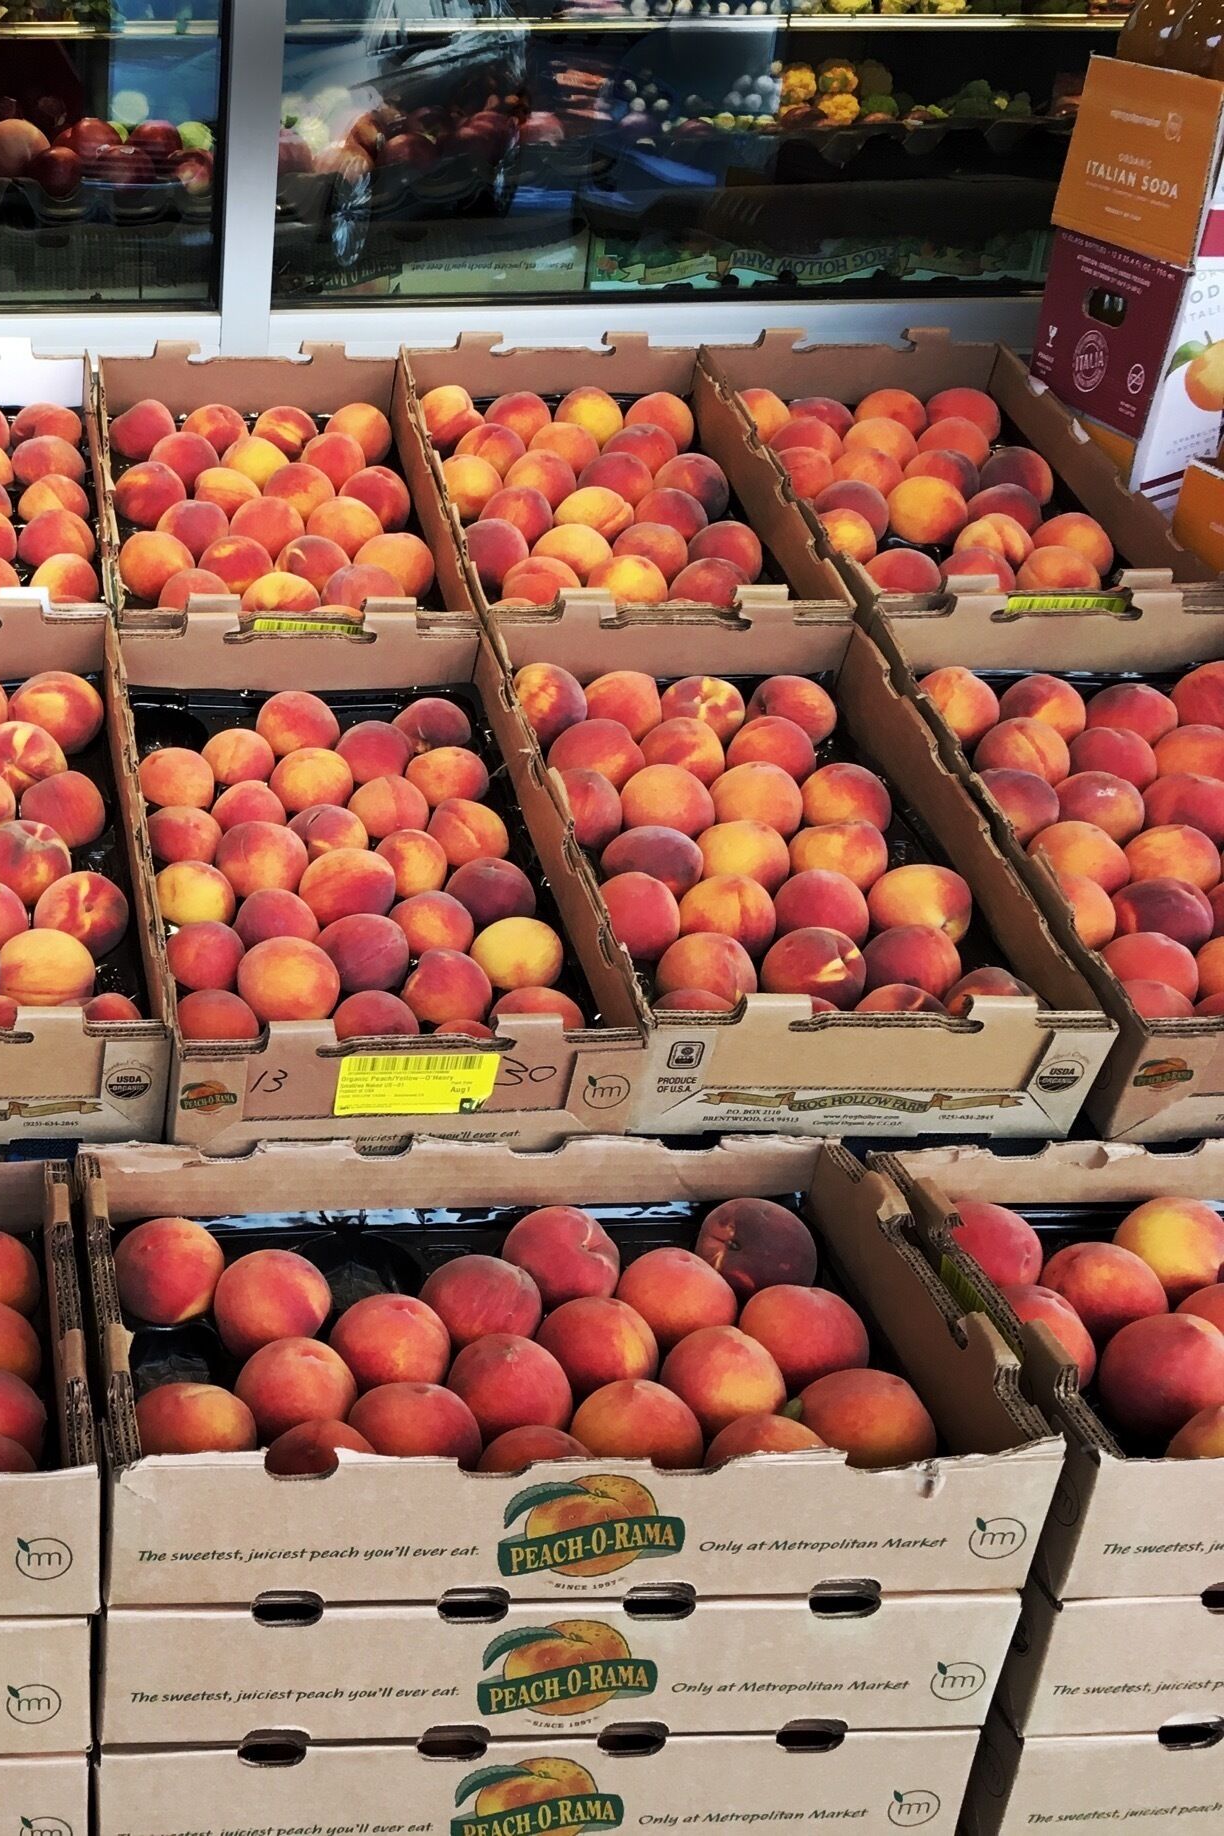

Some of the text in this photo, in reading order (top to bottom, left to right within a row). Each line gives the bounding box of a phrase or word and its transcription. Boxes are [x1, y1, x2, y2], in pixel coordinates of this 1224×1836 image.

[1086, 160, 1137, 188] ITALIAN
[1140, 175, 1179, 200] SODA
[1075, 351, 1105, 372] ITALIA
[495, 1056, 558, 1086] 30
[657, 1076, 698, 1084] PRODUCE
[1049, 1068, 1076, 1076] USDA
[250, 1069, 289, 1093] 13
[790, 1094, 927, 1112] FROG HOLLOW FARM
[138, 1544, 480, 1563] The sweetest, juiciest peach you'll ever eat.
[510, 1522, 678, 1576] PEACH-O-RAMA
[700, 1536, 948, 1554] Only at Metropolitan Market
[1102, 1543, 1130, 1555] The
[1132, 1541, 1205, 1554] sweetest,
[554, 1583, 589, 1592] SINCE
[130, 1686, 460, 1704] The sweetest, juiciest peach you'll ever eat.
[488, 1665, 650, 1714] PEACH-O-RAMA
[672, 1679, 910, 1696] Only at Metropolitan Market
[1052, 1680, 1212, 1696] The sweetest, juiciest
[462, 1800, 616, 1836] PEACH-O-RAMA
[638, 1808, 869, 1827] Only at Metropolitan Market
[277, 1824, 323, 1836] peach
[327, 1823, 370, 1836] you'll
[373, 1824, 404, 1834] ever
[406, 1822, 434, 1832] eat.
